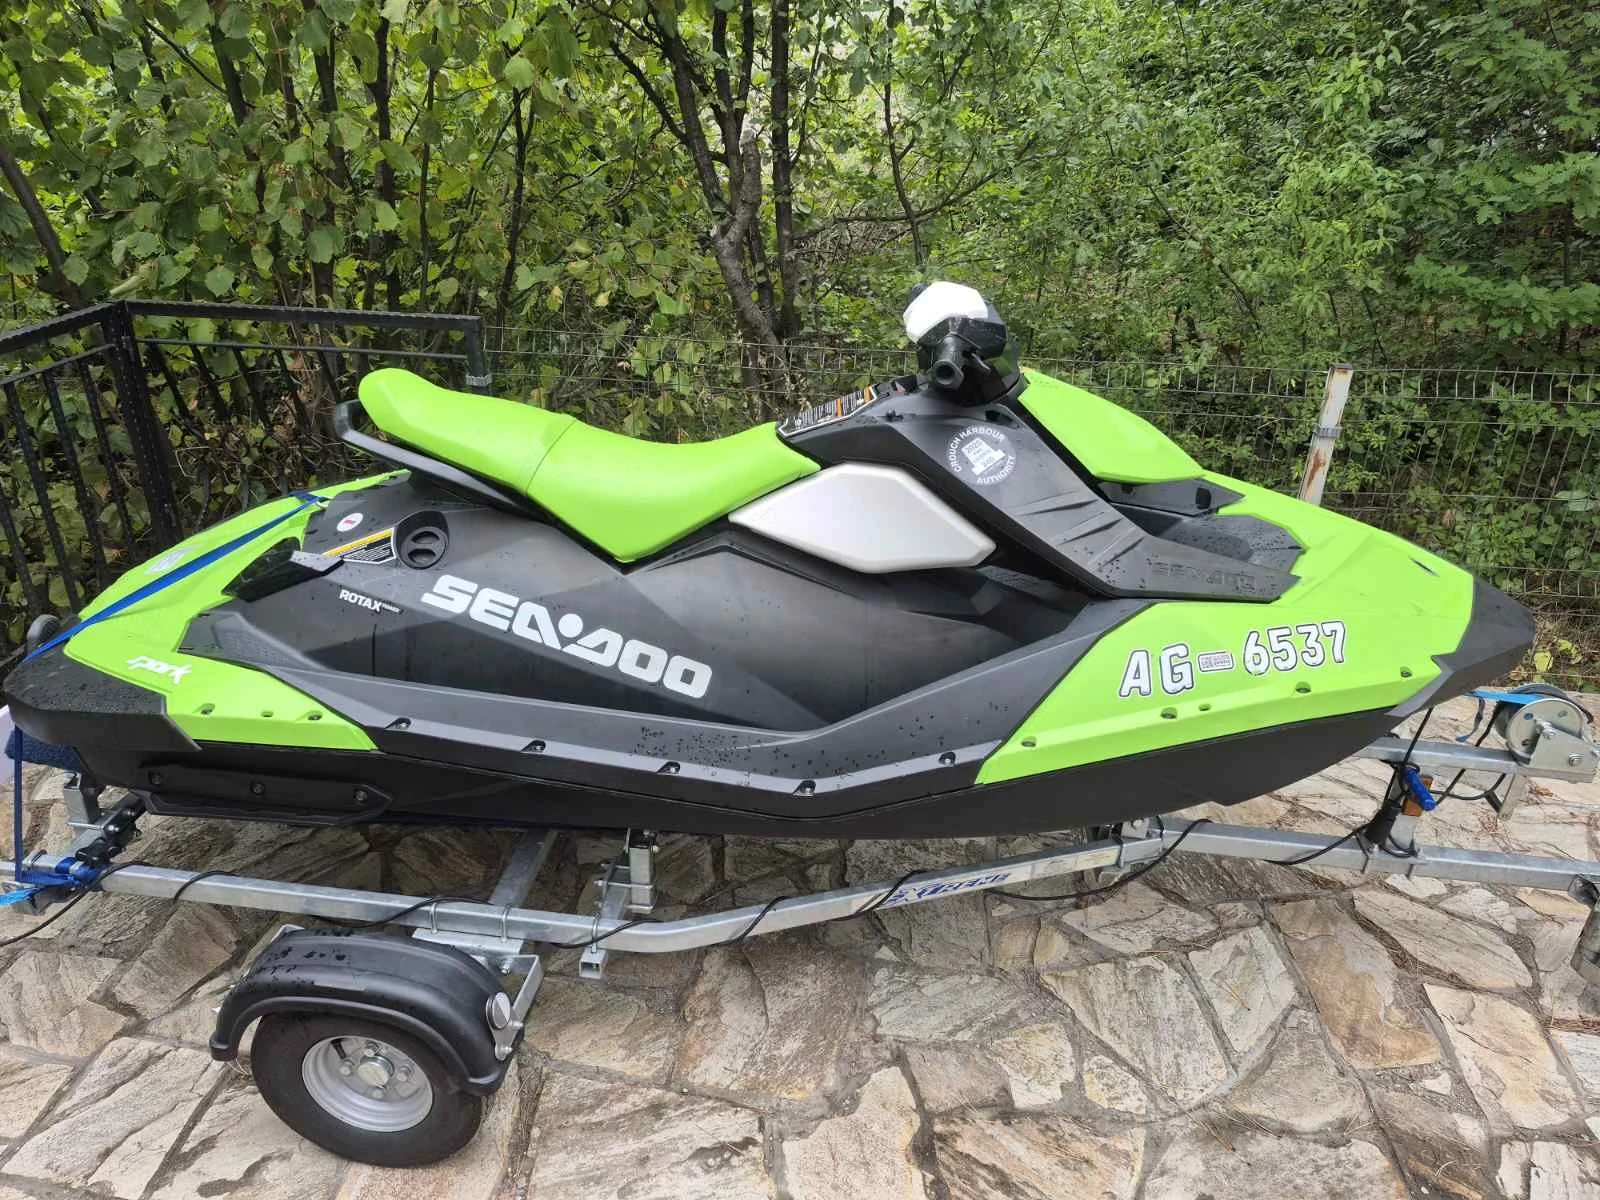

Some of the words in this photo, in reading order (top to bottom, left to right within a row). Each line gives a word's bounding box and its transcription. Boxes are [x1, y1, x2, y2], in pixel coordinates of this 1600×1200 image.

[949, 437, 962, 472] CROUCH
[958, 427, 1005, 441] HARBOUR
[338, 589, 382, 613] ROTAX
[1242, 620, 1347, 676] 6537
